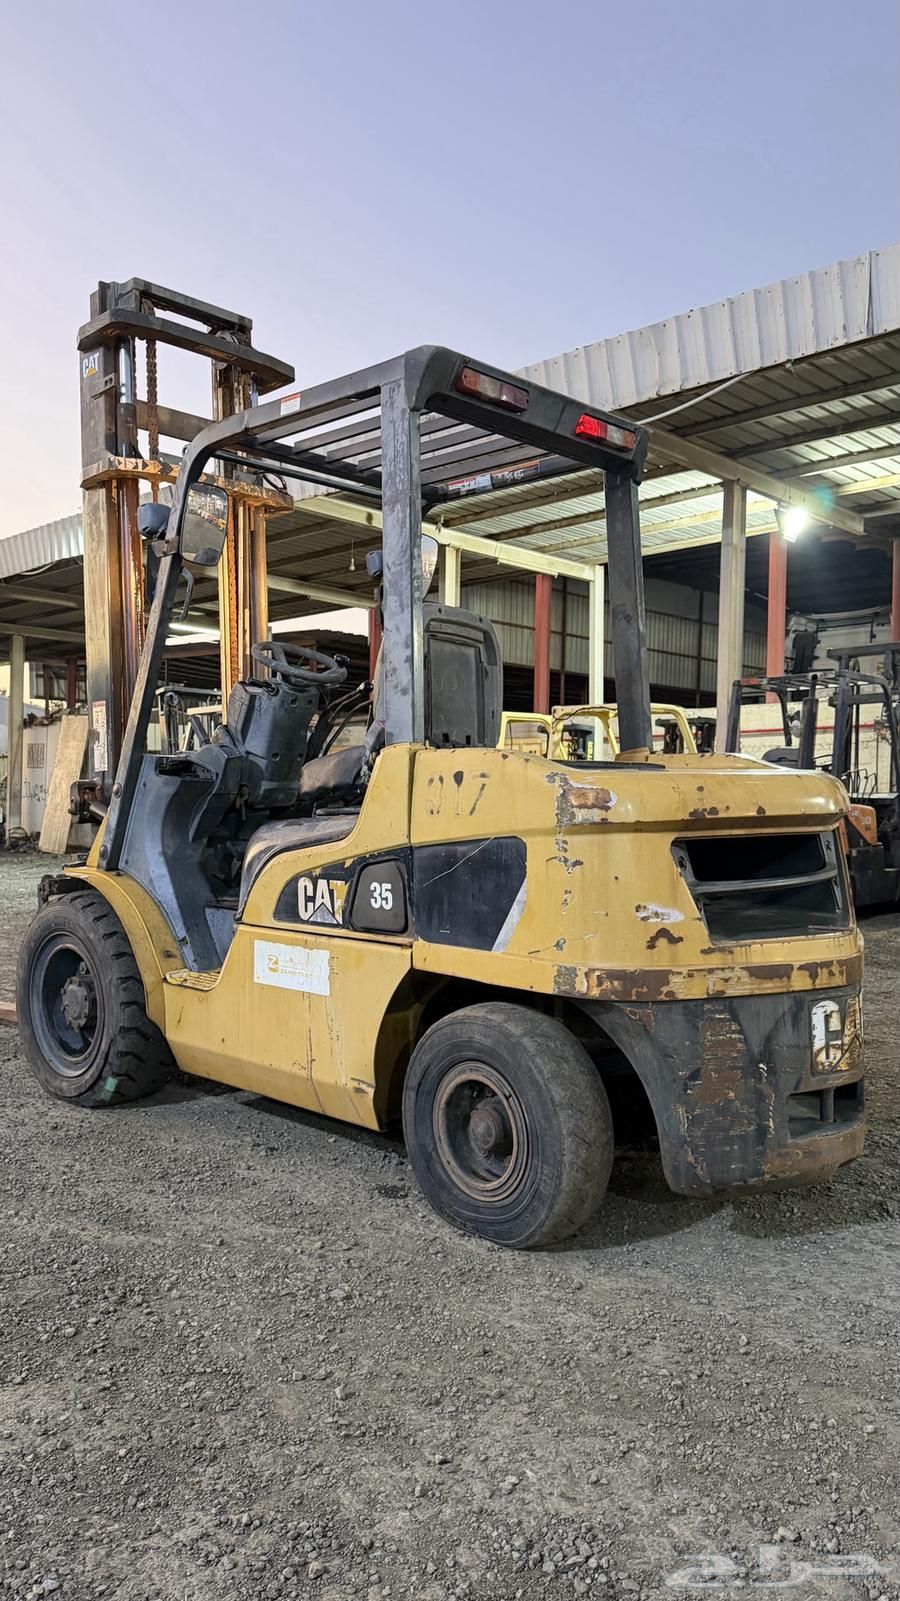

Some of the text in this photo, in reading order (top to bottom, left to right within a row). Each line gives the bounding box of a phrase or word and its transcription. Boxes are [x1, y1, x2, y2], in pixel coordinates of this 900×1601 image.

[82, 352, 100, 378] CAT
[297, 877, 348, 924] CAT
[369, 881, 393, 910] 35
